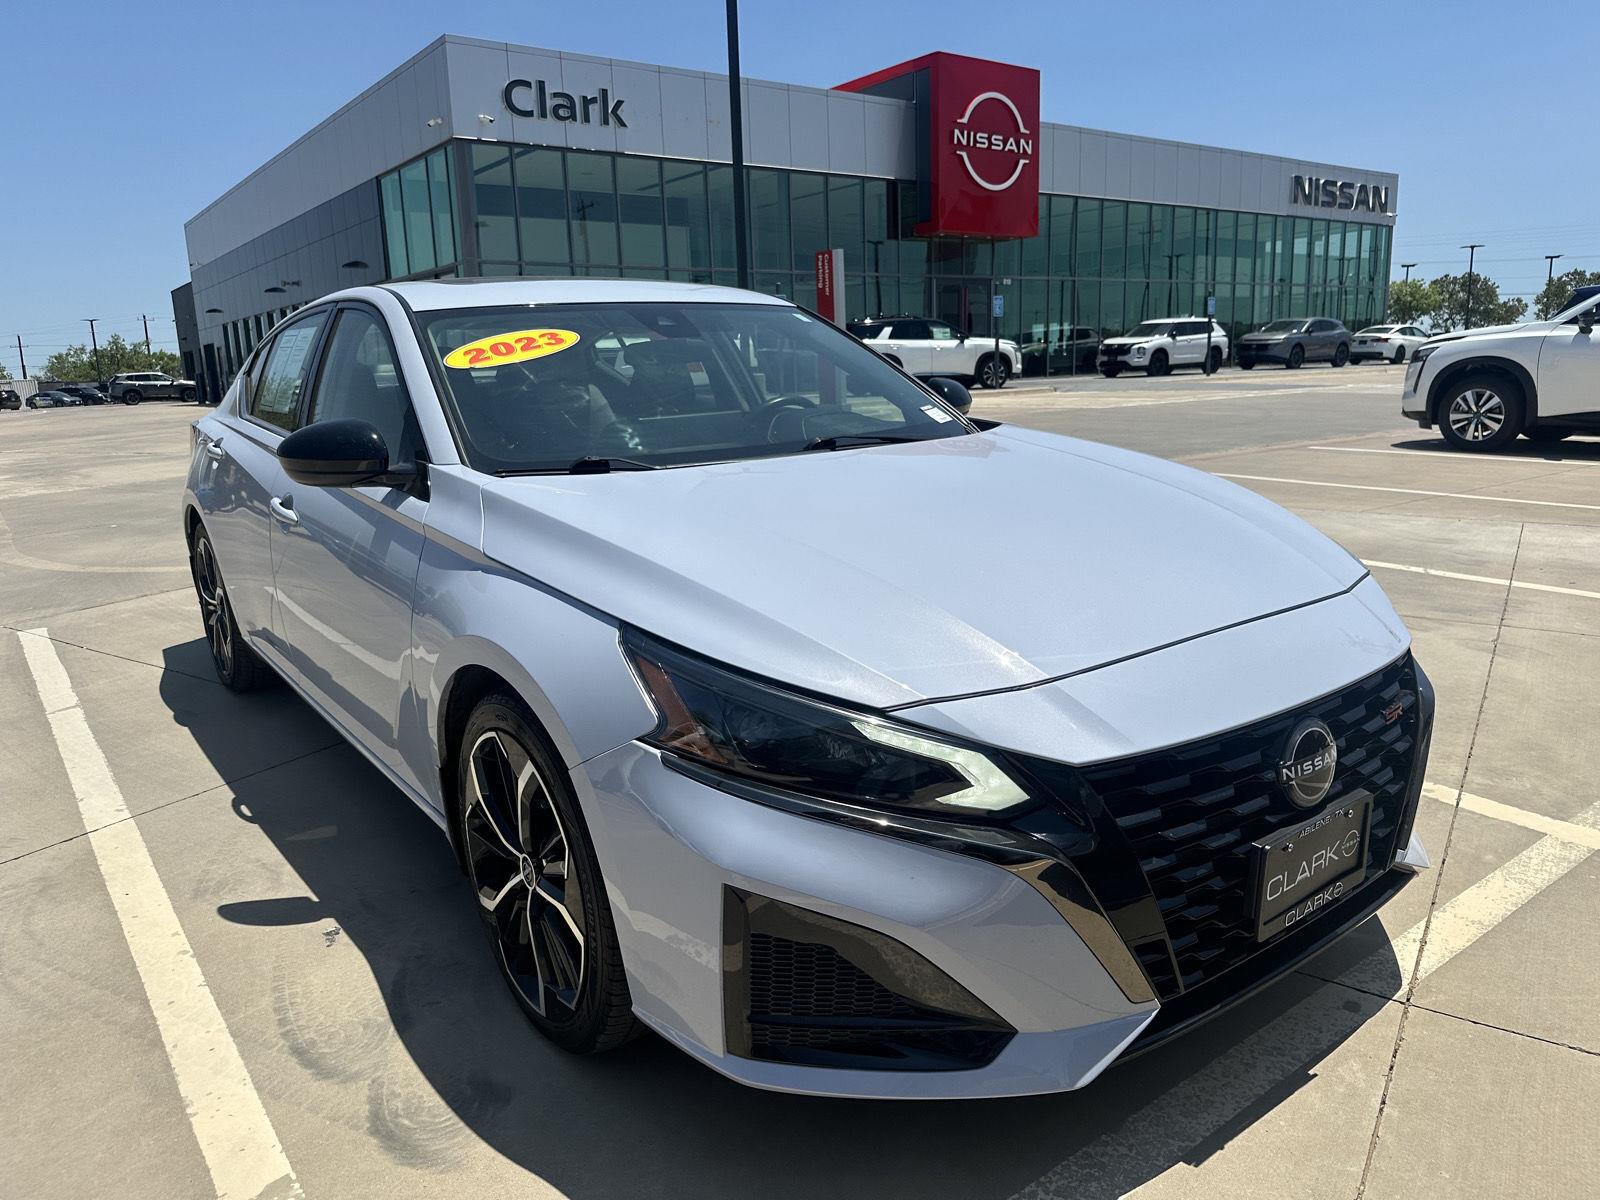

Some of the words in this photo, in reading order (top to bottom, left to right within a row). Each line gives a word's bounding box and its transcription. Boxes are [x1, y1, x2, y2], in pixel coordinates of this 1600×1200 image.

[503, 79, 628, 128] Clark
[953, 128, 1032, 155] NISSAN
[1291, 175, 1389, 214] NISSAN
[462, 332, 566, 365] 2023
[1282, 749, 1337, 781] NISSAN
[1266, 840, 1341, 901] CLARK
[1285, 887, 1333, 927] CLARK
